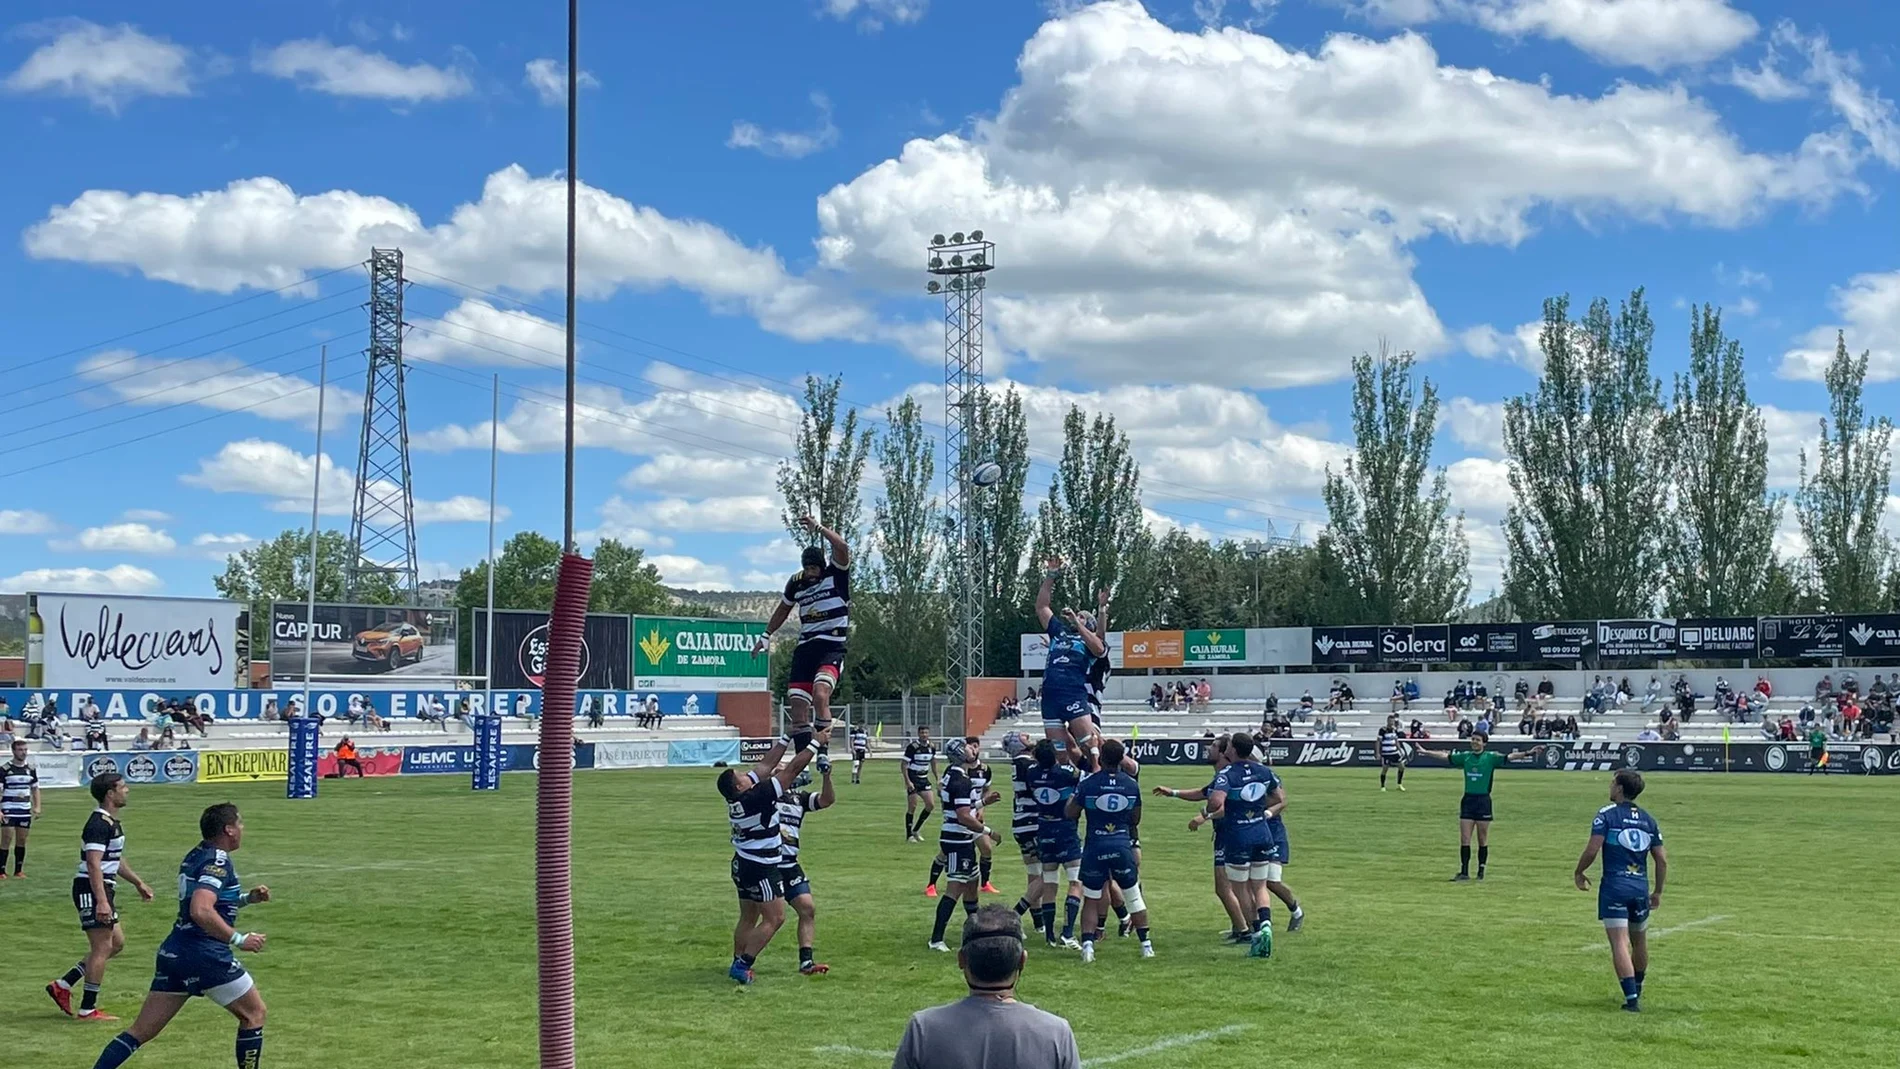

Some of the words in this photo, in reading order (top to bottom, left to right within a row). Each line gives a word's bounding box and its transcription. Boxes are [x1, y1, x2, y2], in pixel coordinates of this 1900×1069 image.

[275, 612, 295, 620] Nuevo
[275, 621, 342, 640] CAPTUR
[1704, 627, 1755, 641] DELUARC
[1789, 625, 1811, 639] La
[1876, 630, 1895, 638] CAJA
[676, 631, 712, 651] CAJA
[713, 632, 766, 651] RURA
[1383, 634, 1446, 653] Solera
[1460, 637, 1477, 646] GO
[1132, 644, 1146, 653] GO
[1210, 645, 1239, 653] RURAL
[677, 655, 688, 664] DE
[692, 655, 726, 665] ZAMORA
[105, 676, 176, 684] www.valdecuevas.es
[391, 692, 662, 716] ENTREPARE
[597, 748, 620, 761] JOSÉ
[621, 748, 668, 760] PARIENTE
[1131, 743, 1160, 758] cyltv
[1170, 743, 1179, 757] 7
[1190, 744, 1196, 756] 8
[1296, 741, 1354, 765] Handy
[1581, 751, 1595, 761] Rugby
[1601, 751, 1620, 760] Salvador
[306, 732, 314, 798] LESAFFRE
[410, 752, 456, 764] UEMC
[488, 729, 497, 790] LESAFFRE
[1040, 788, 1050, 803] 4
[1249, 784, 1256, 799] 7
[1107, 795, 1119, 810] 6
[1629, 829, 1641, 850] 9
